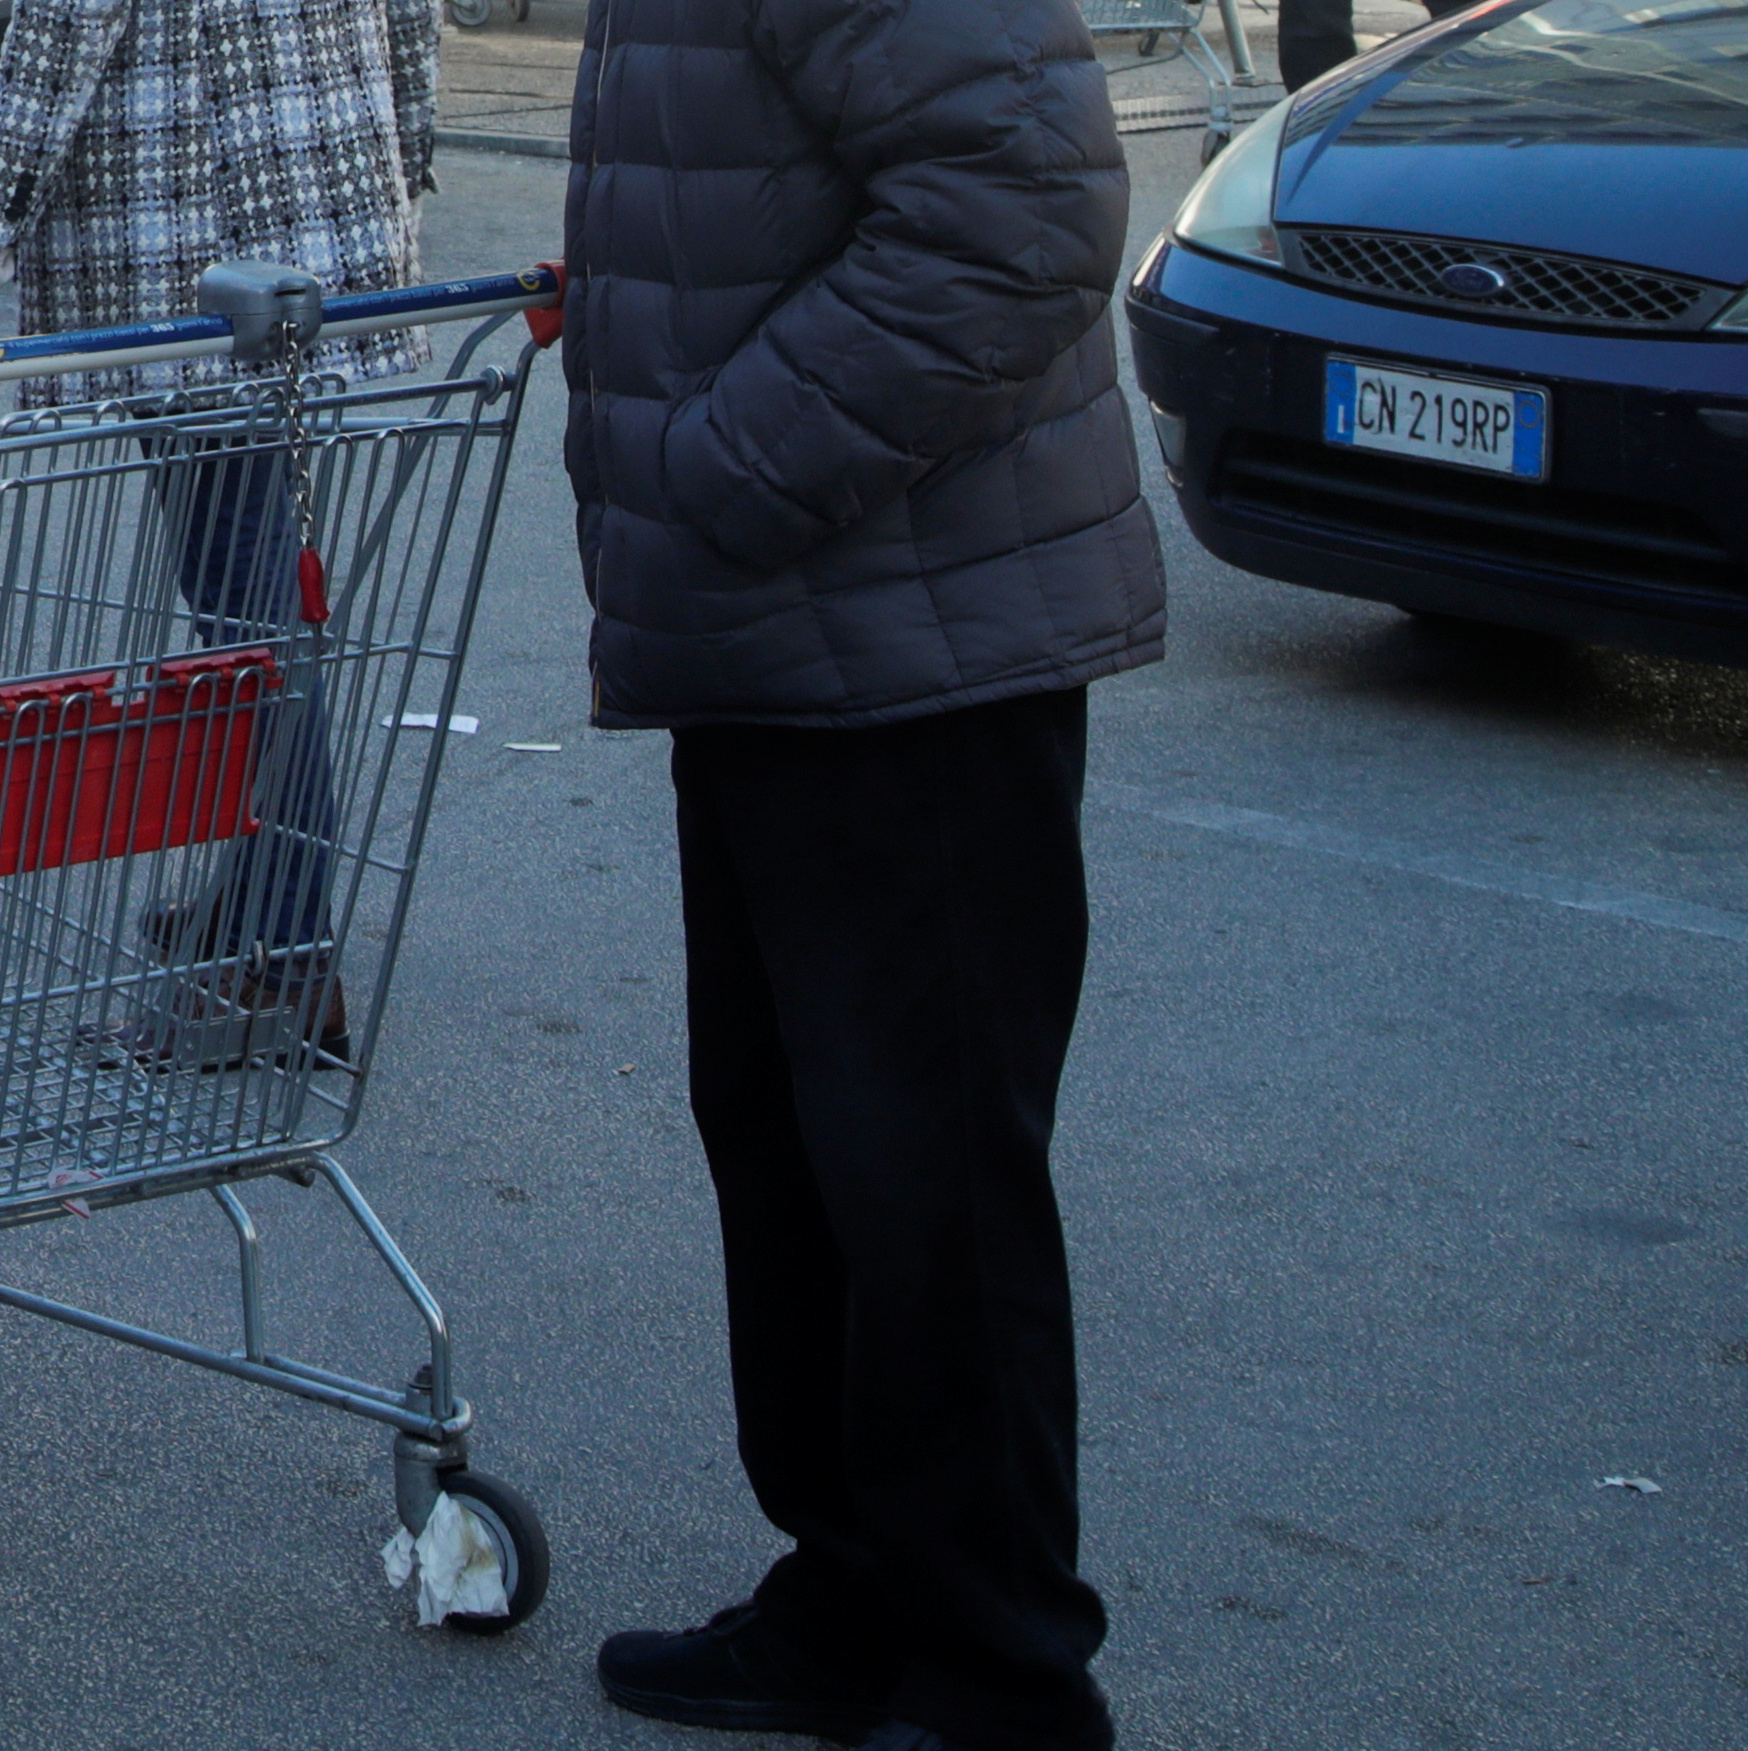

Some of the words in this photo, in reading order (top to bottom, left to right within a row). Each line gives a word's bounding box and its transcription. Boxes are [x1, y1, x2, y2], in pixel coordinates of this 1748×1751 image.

[150, 322, 175, 333] 365
[1359, 381, 1397, 435] CN
[1408, 390, 1511, 455] 219RP
